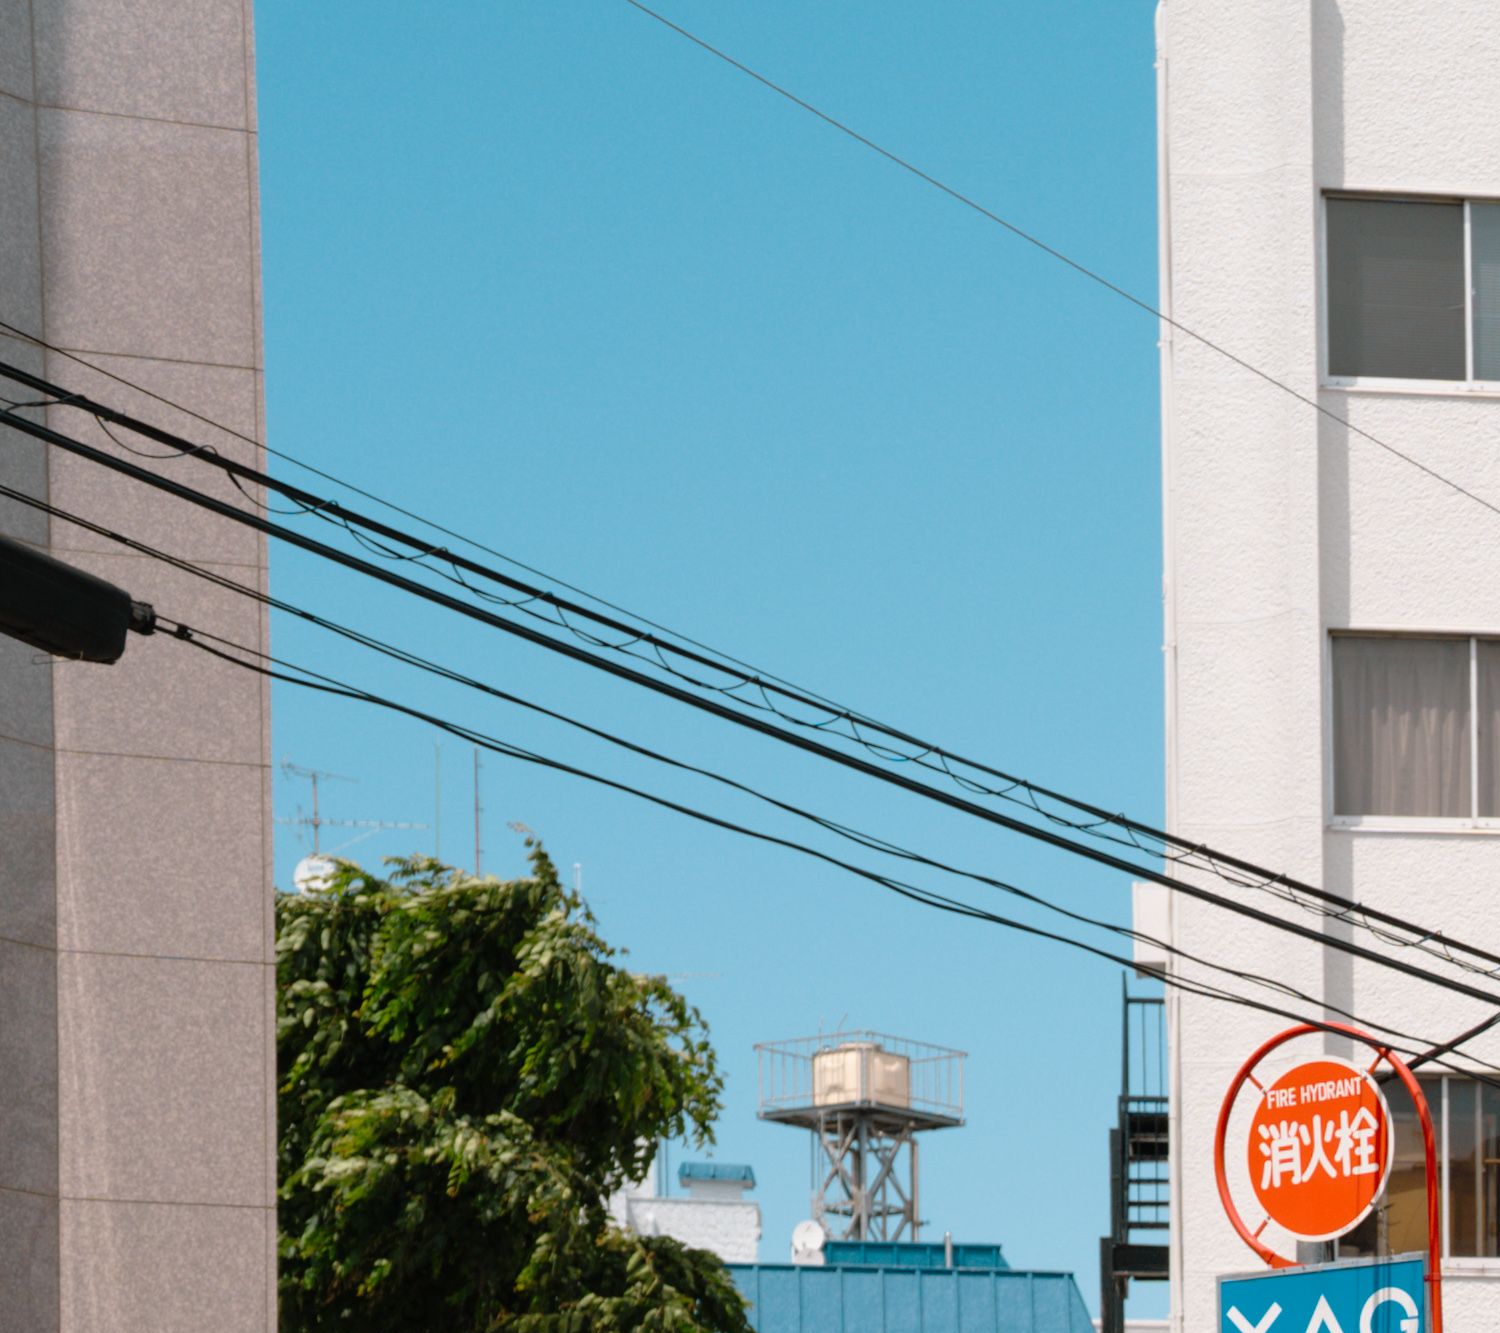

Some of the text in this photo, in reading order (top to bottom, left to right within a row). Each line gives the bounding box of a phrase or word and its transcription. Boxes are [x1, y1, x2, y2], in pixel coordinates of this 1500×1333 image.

[1266, 1075, 1363, 1109] FIRE HYDRANT
[1257, 1105, 1381, 1191] 消火栓
